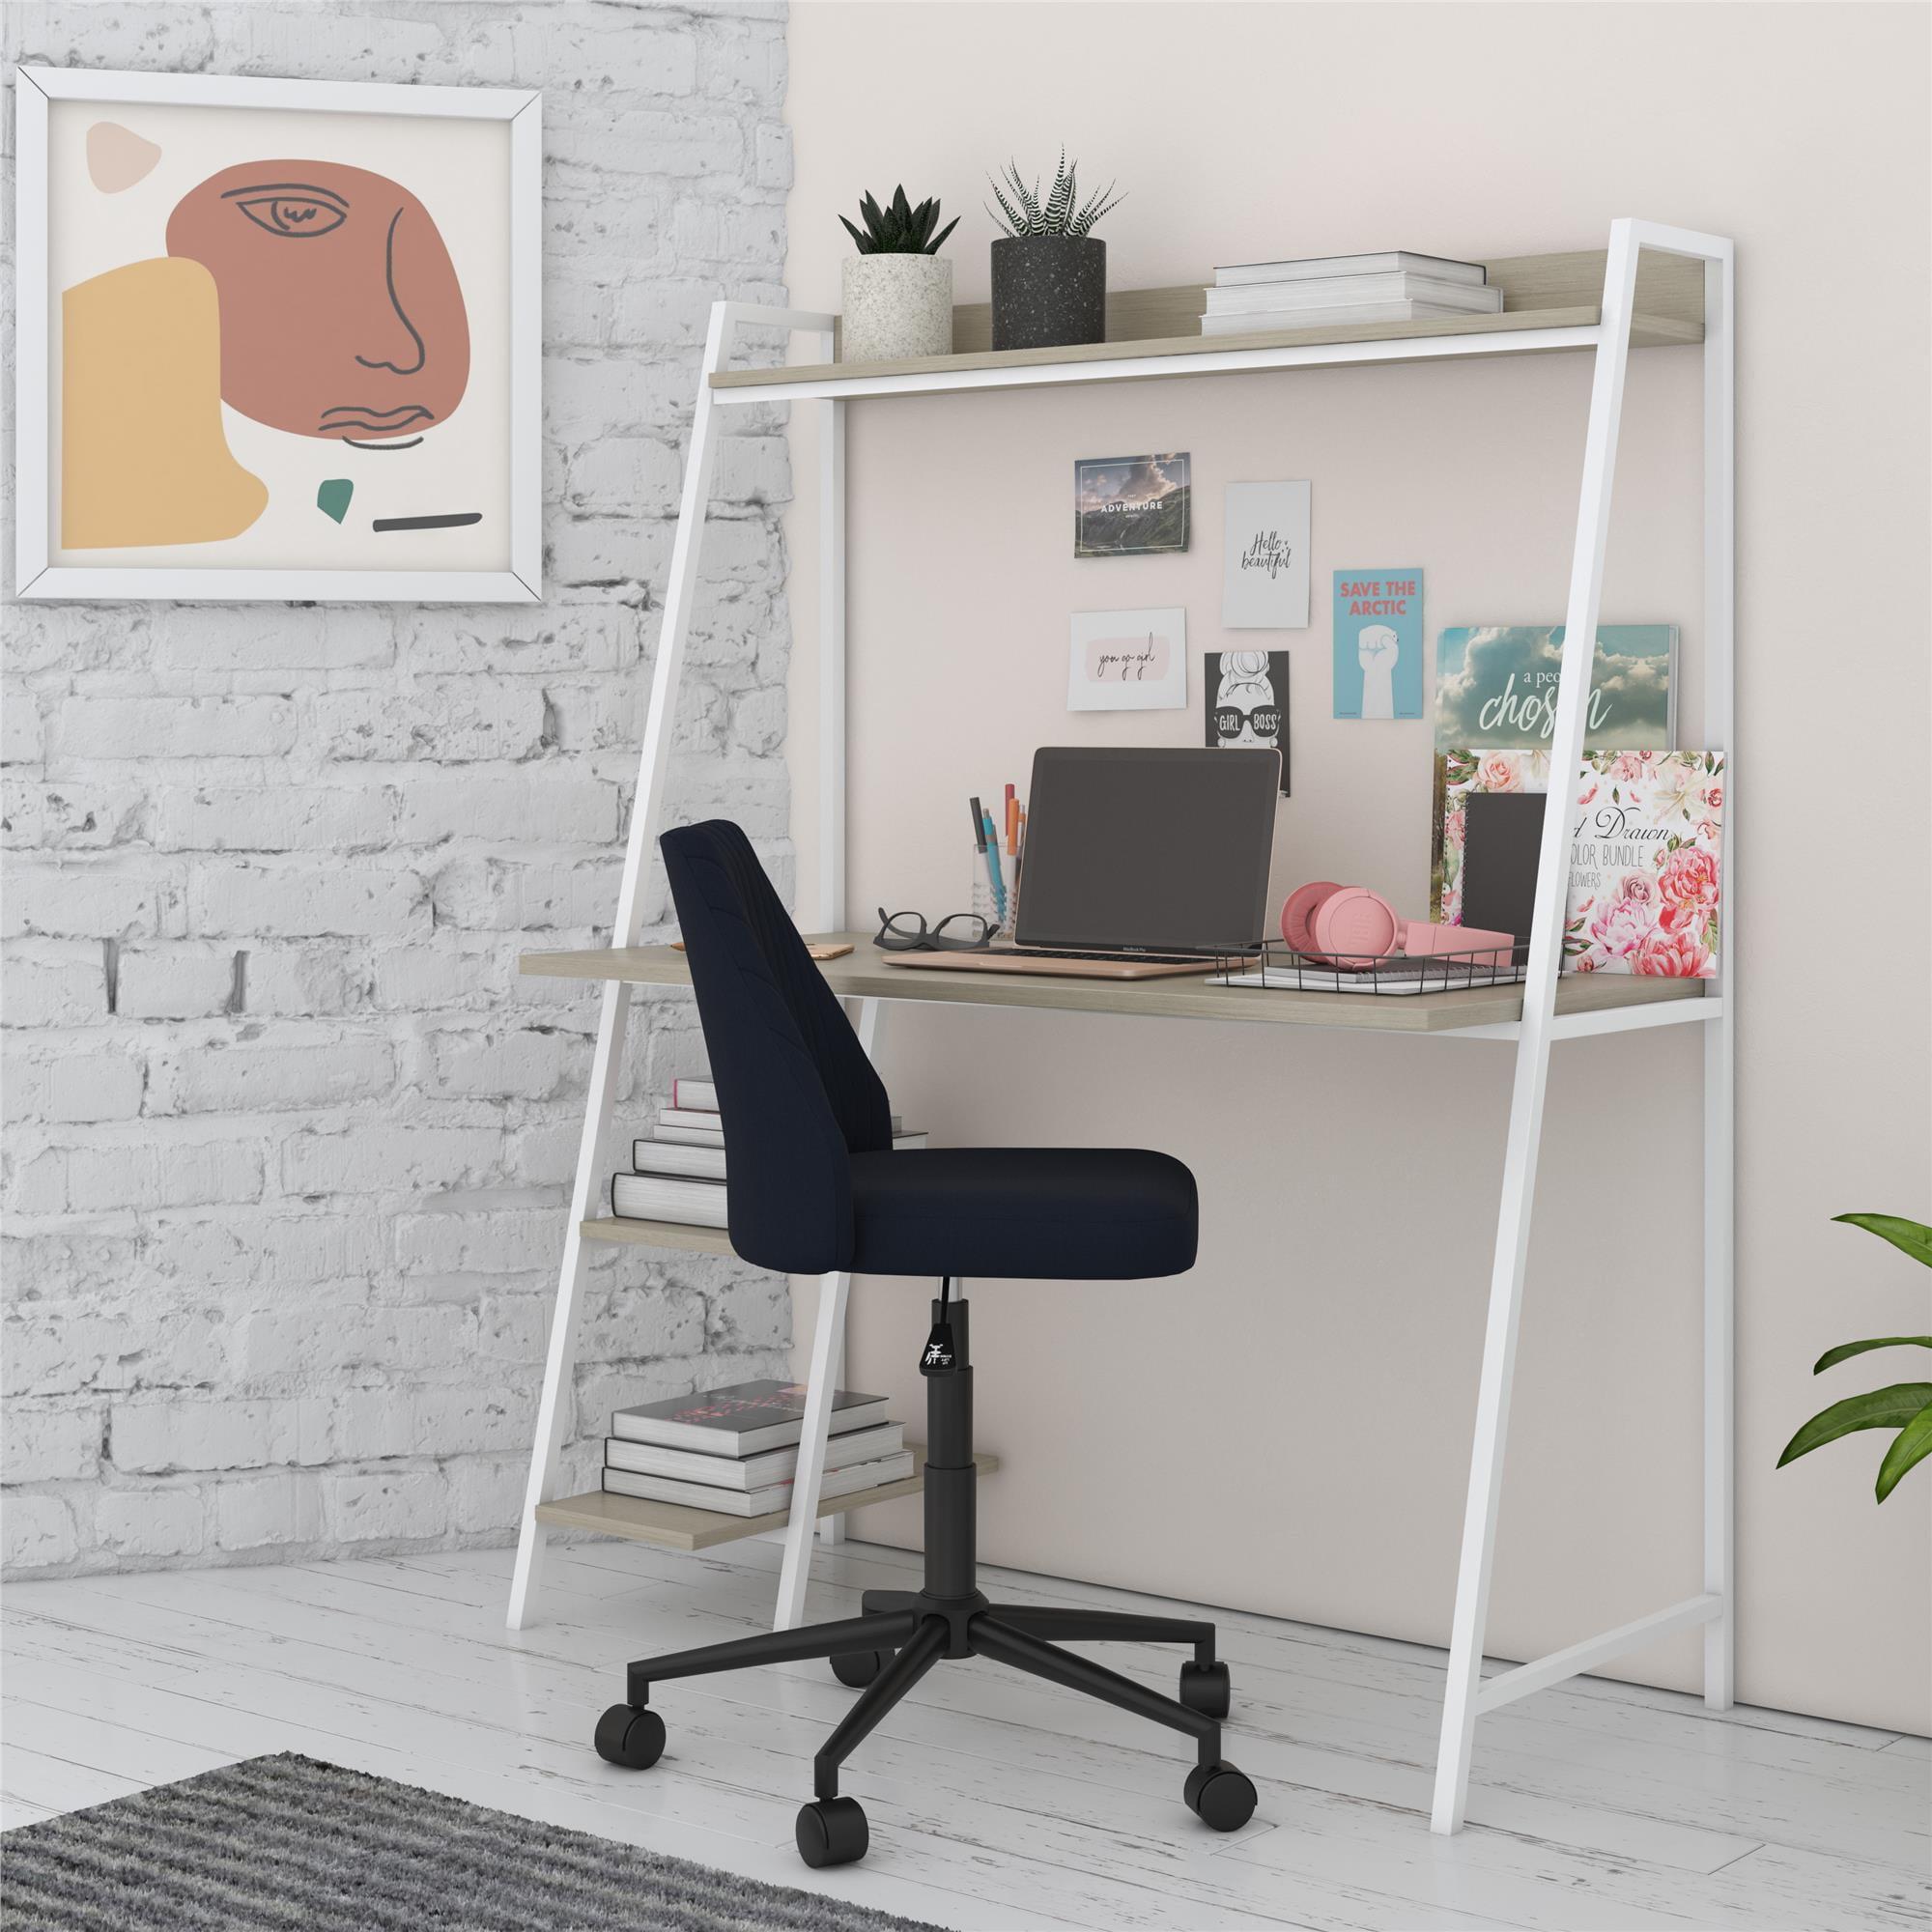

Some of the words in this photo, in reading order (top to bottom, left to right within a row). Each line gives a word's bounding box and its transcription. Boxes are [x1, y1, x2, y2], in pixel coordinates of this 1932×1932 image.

[1101, 501, 1163, 513] ADVENTURE
[1250, 530, 1282, 556] Hello
[1241, 548, 1291, 580] beautiful
[1340, 582, 1380, 597] SAVE
[1385, 581, 1415, 596] THE
[1349, 600, 1406, 615] ARCTIC
[1523, 671, 1531, 683] a
[1536, 671, 1561, 689] peo
[1479, 672, 1612, 739] chosn
[1219, 714, 1240, 731] GIRL
[1253, 713, 1277, 730] BOSS
[1594, 806, 1670, 840] Drawn
[1570, 842, 1599, 870] OLOR
[1603, 844, 1644, 867] BUNDLE
